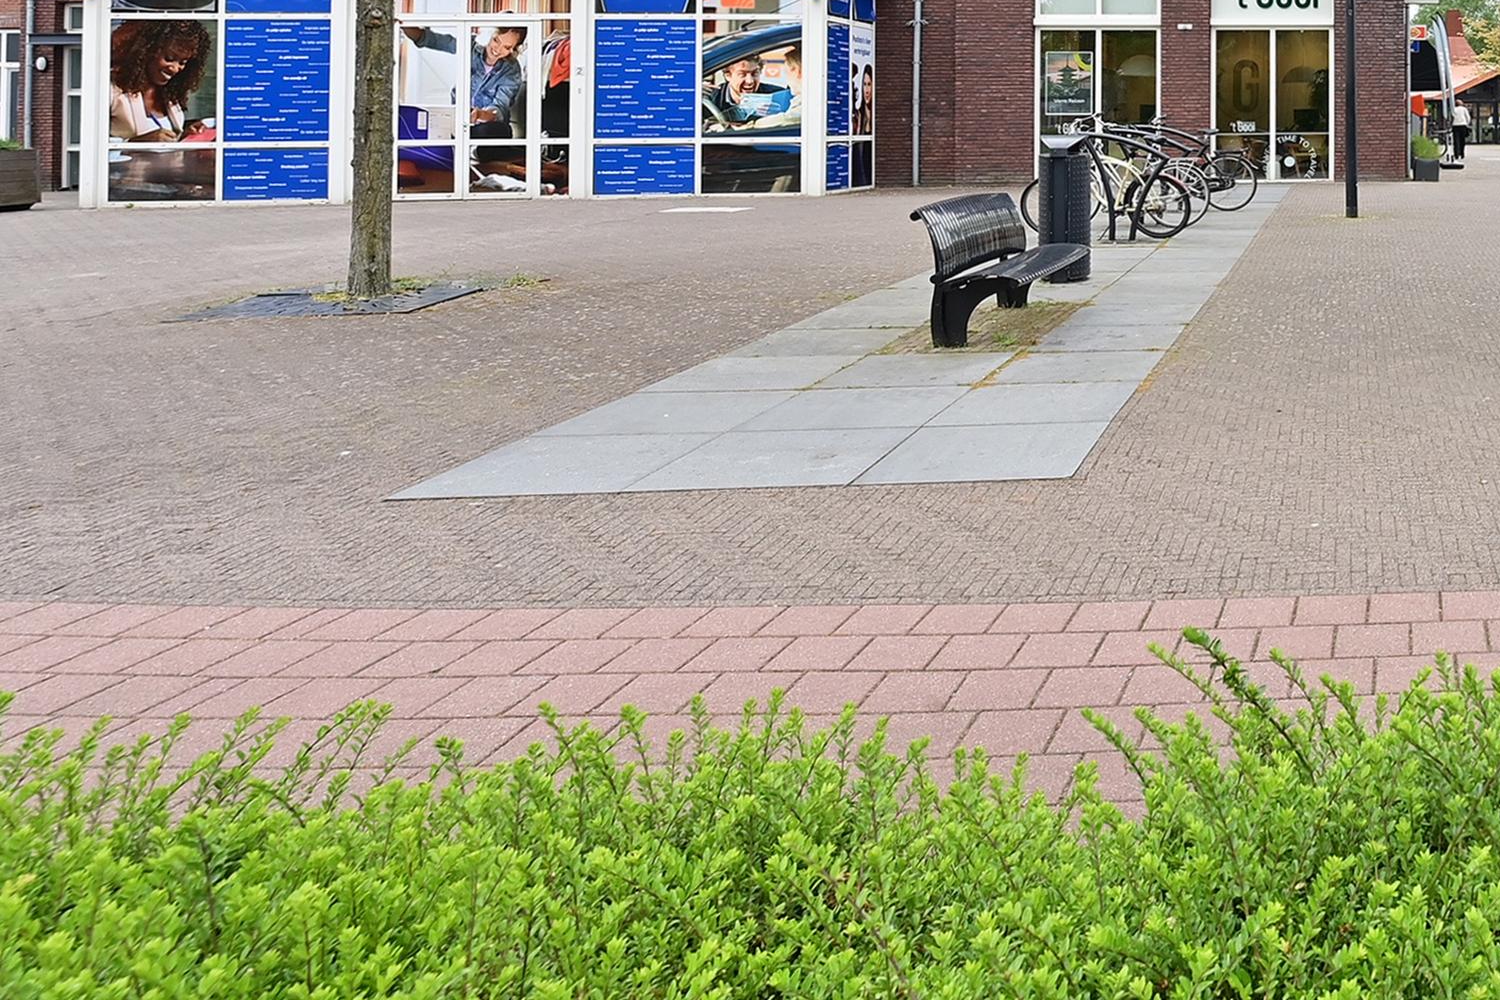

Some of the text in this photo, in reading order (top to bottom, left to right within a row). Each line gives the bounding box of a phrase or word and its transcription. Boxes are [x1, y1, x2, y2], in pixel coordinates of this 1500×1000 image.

[1232, 59, 1260, 113] G
[1276, 134, 1318, 180] TIME TO TRAVEL
